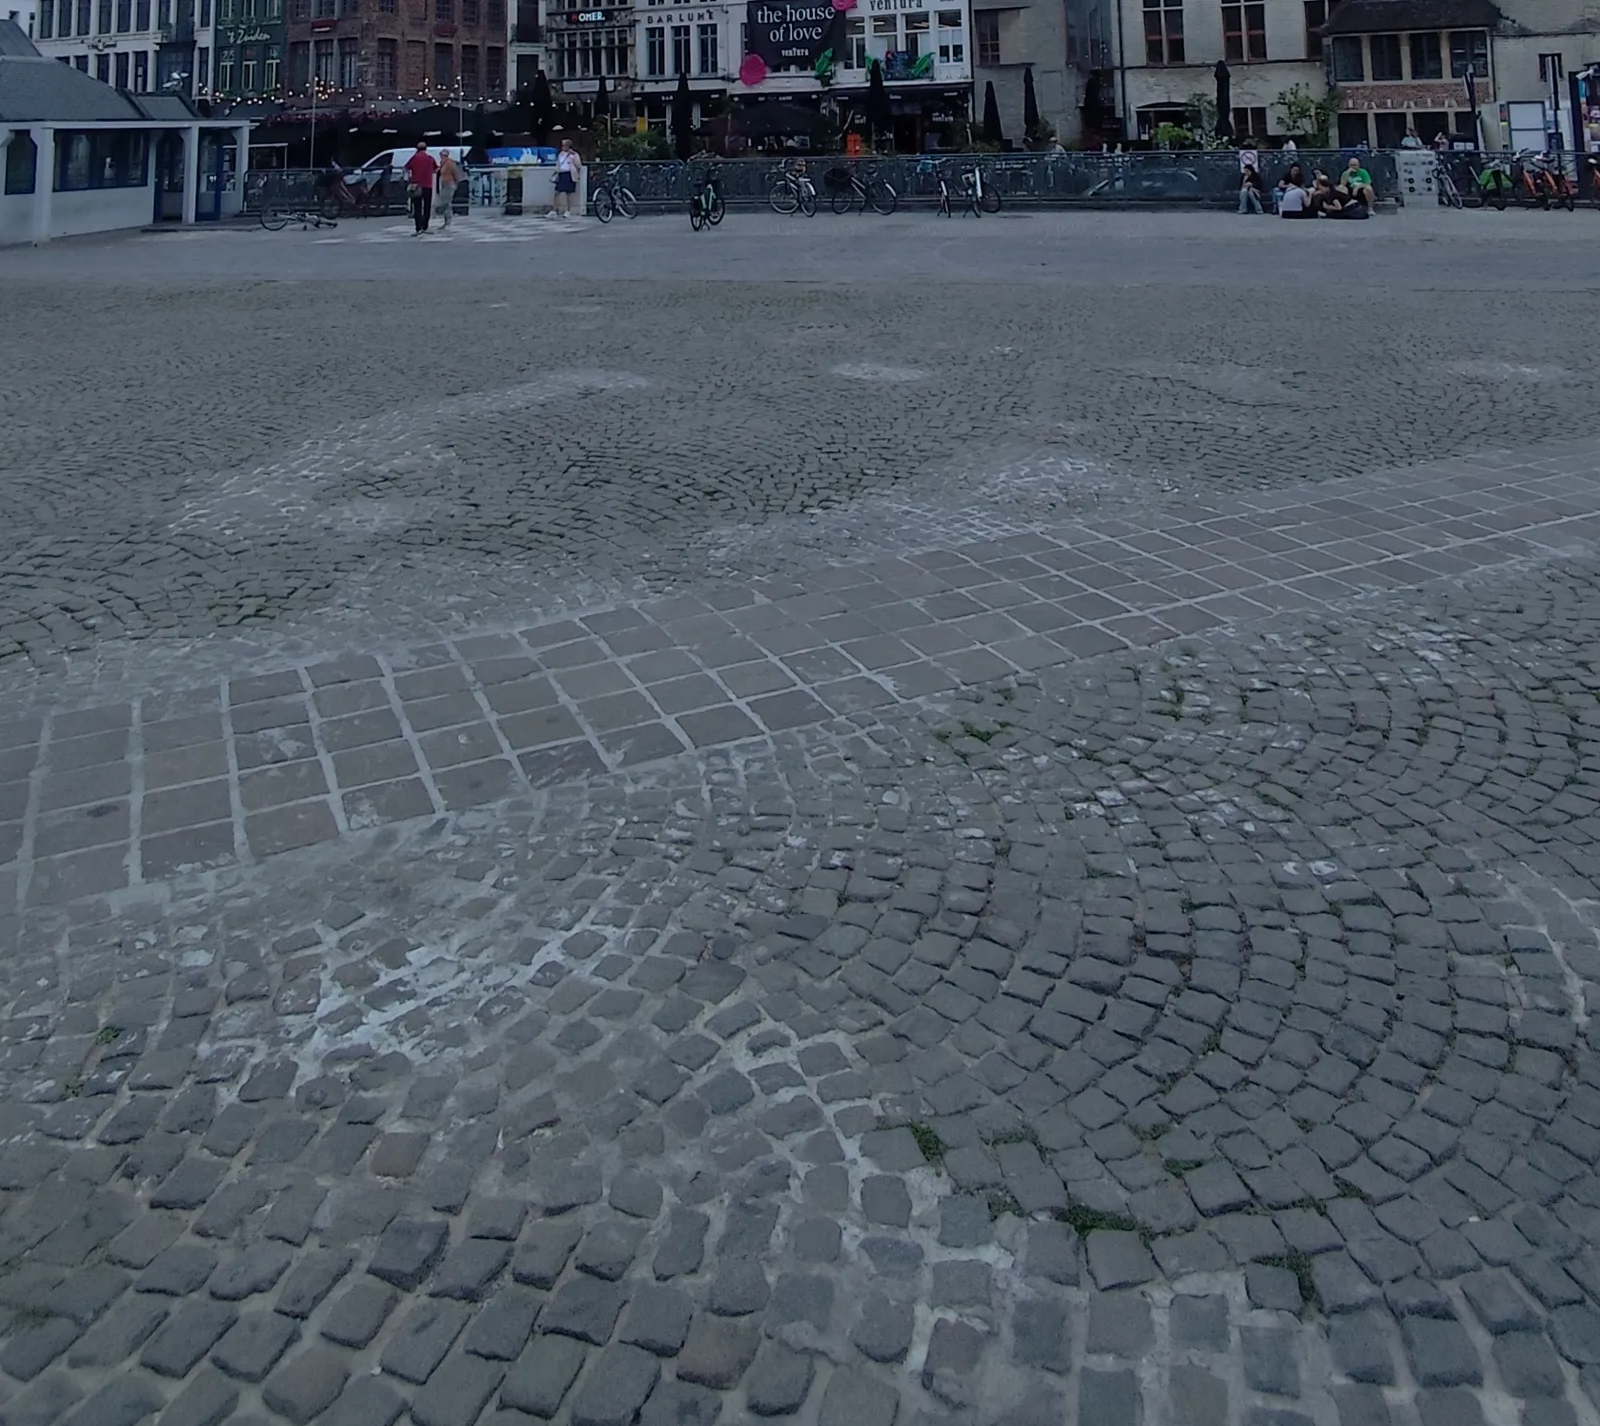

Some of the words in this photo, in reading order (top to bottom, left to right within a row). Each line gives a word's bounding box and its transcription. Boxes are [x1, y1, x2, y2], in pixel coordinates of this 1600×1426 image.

[647, 14, 673, 24] BAR
[757, 6, 782, 24] the
[786, 4, 835, 22] house
[770, 24, 786, 42] of
[789, 23, 822, 41] love
